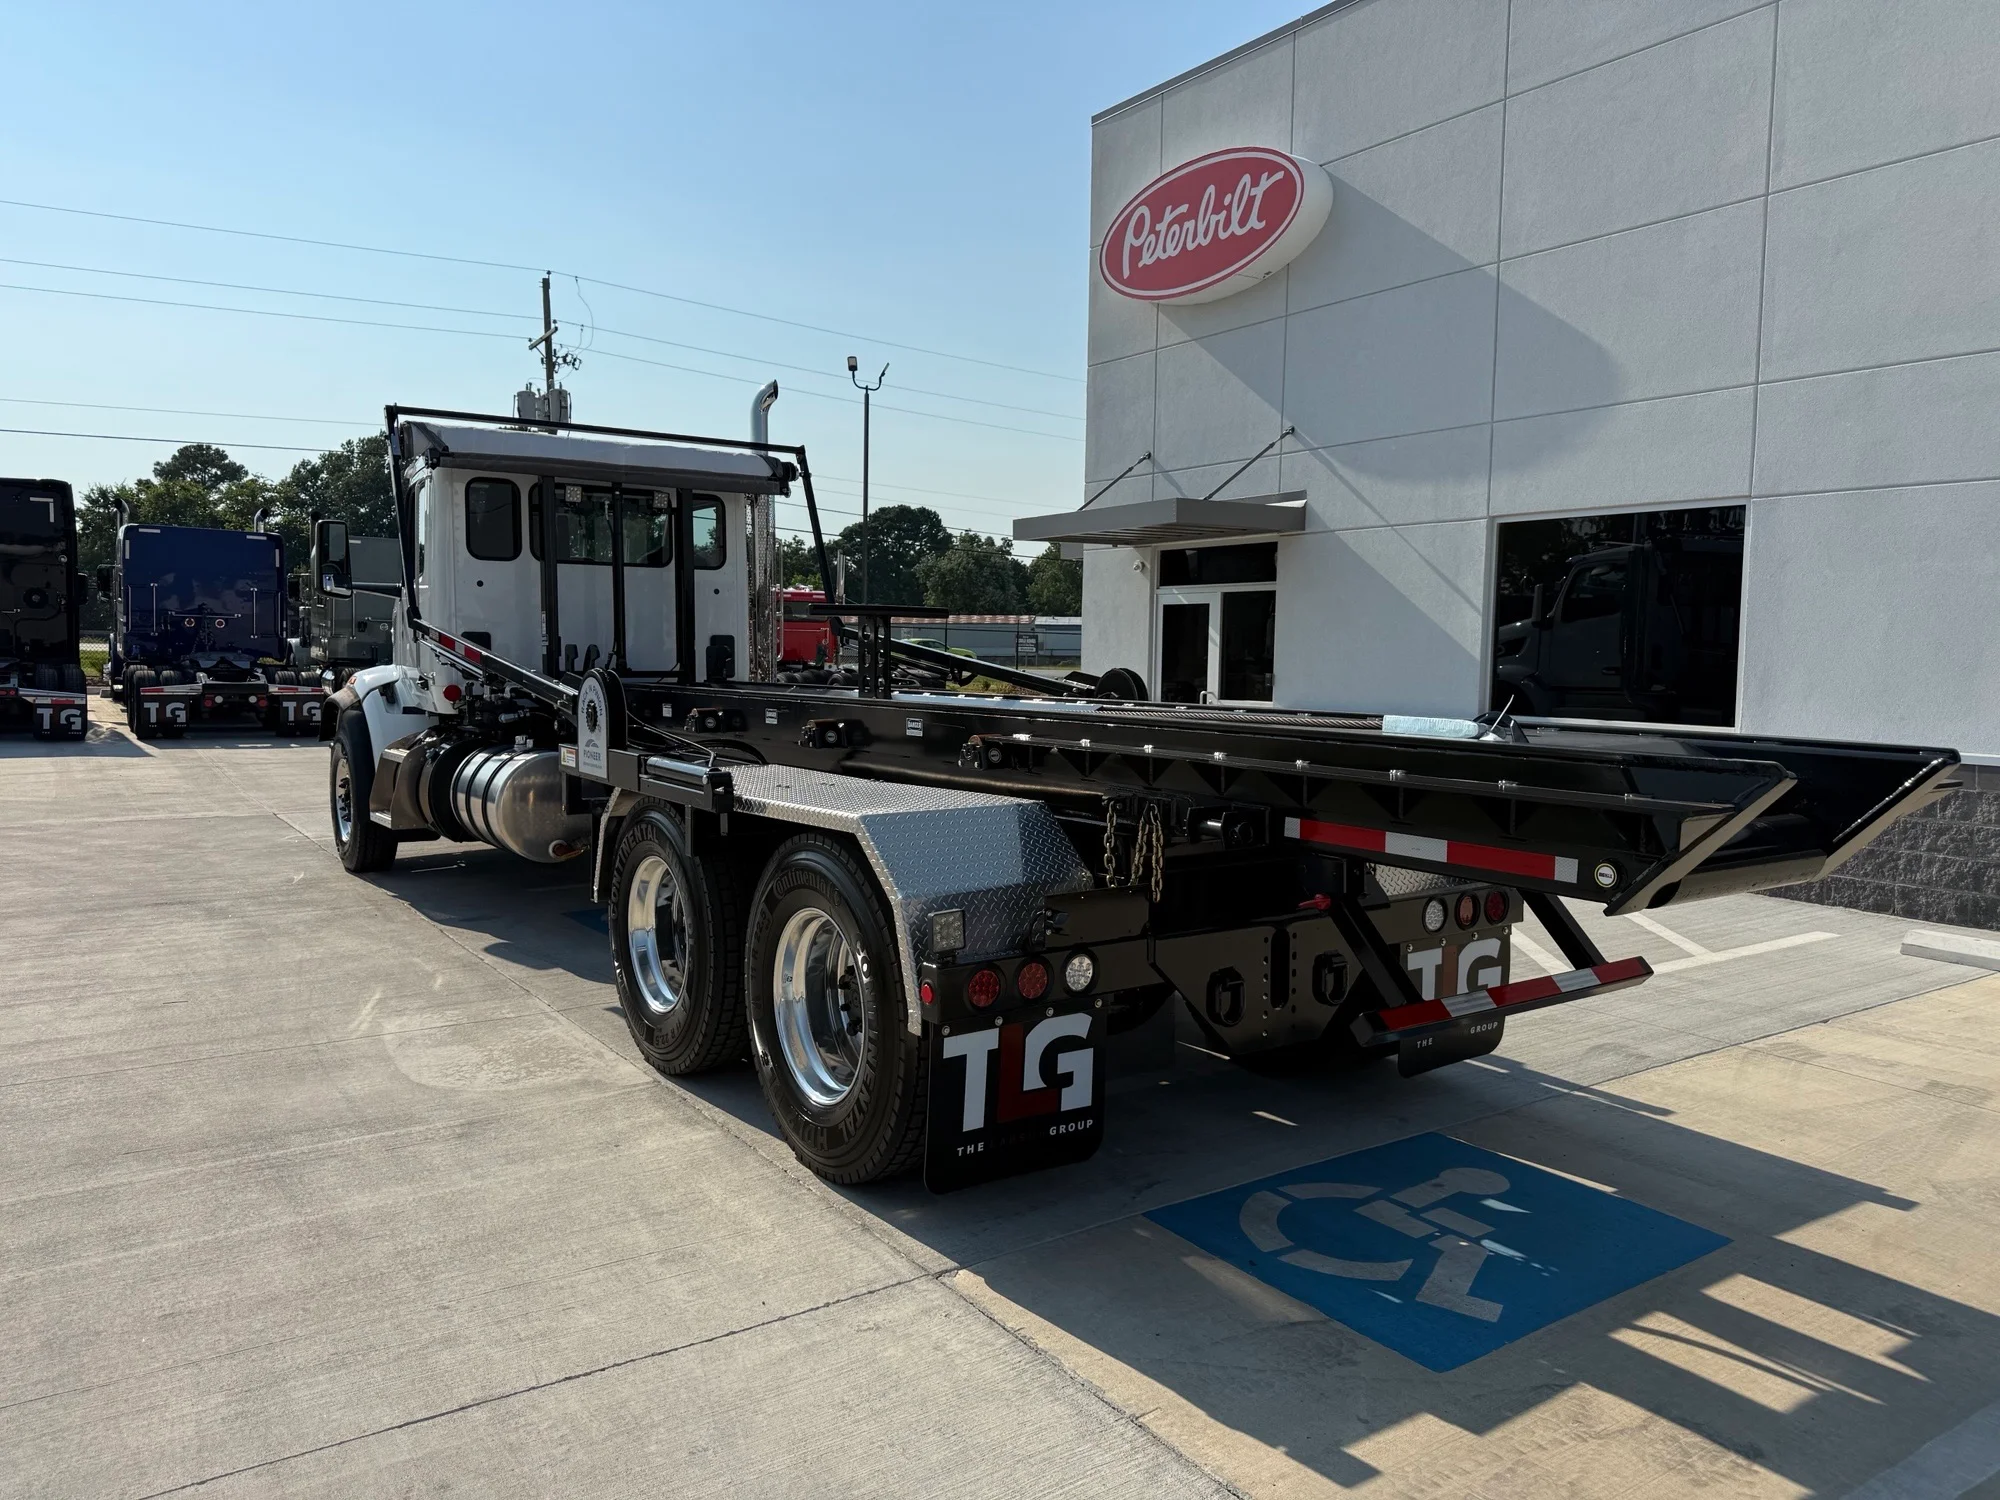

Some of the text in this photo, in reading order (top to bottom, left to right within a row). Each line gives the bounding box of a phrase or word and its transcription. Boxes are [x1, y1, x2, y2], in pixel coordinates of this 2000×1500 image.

[1123, 170, 1285, 280] Peterbilt
[583, 749, 602, 762] PIONEER
[610, 823, 659, 920] CONTINENTAL
[1416, 1021, 1498, 1050] THE GROUP
[957, 1141, 985, 1157] THE
[1049, 1119, 1094, 1136] GROUP
